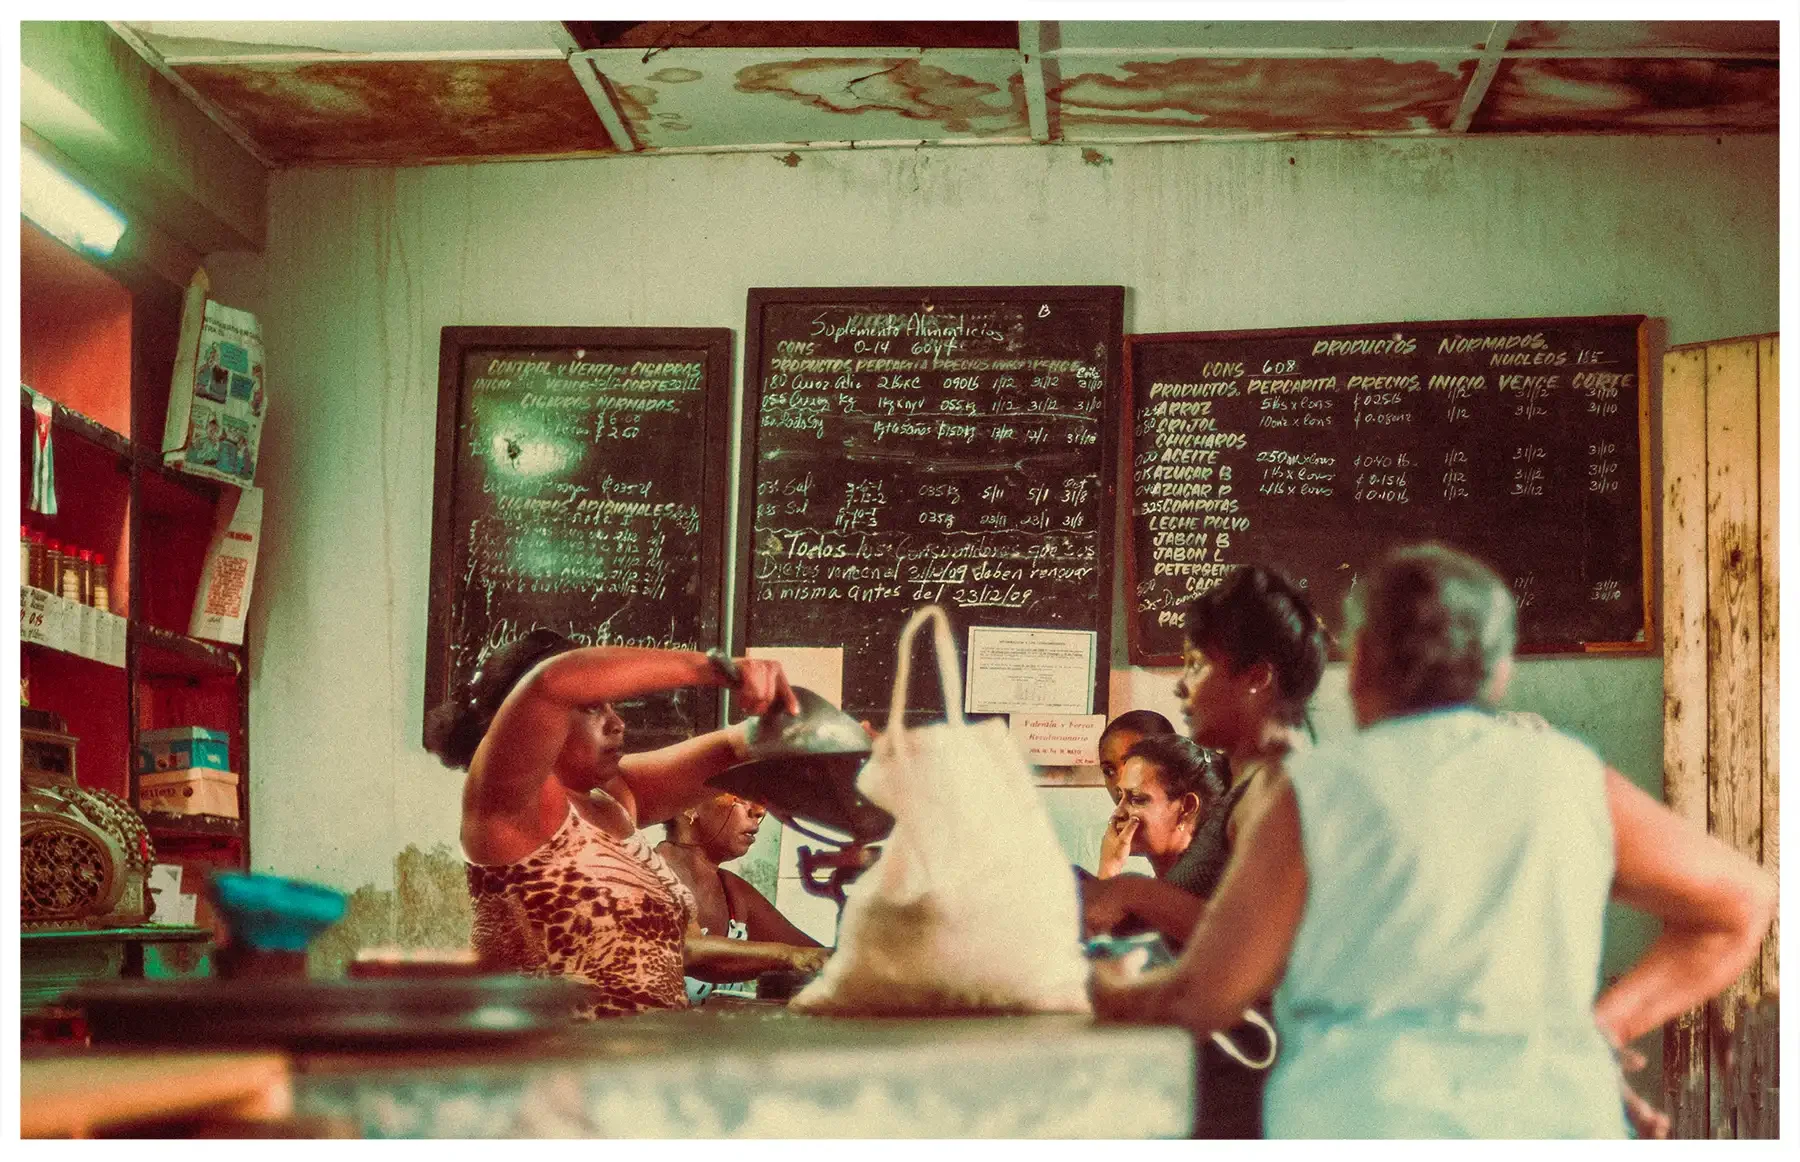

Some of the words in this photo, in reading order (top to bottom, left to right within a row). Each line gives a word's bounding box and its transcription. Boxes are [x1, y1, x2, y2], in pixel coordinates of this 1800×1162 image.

[811, 311, 899, 343] Suplemento
[777, 340, 816, 355] CONS
[1312, 338, 1416, 356] PRODUCTOS
[772, 358, 853, 373] PRODUCTOS
[1490, 352, 1568, 366] NUCLEOS
[487, 359, 550, 377] CONTROL
[630, 361, 702, 378] CIGARROS
[1203, 362, 1244, 377] CONS
[1263, 360, 1296, 374] 608
[1499, 373, 1560, 391] VENCE
[1571, 372, 1633, 389] CORTE
[1156, 401, 1212, 417] ARROZ
[1155, 433, 1248, 450] CHICHAROS
[1161, 448, 1220, 464] ACEITE
[1153, 465, 1213, 481] AZUCAR
[1151, 482, 1212, 498] AZUCAR
[1162, 499, 1240, 514] COMPOTAS
[1149, 515, 1200, 531] LECHE
[1203, 517, 1250, 531] POLVO
[784, 532, 847, 559] Todos
[1152, 532, 1208, 547] JABON
[1215, 532, 1231, 548] B
[1152, 547, 1208, 562] JABON
[1214, 549, 1225, 562] L
[780, 585, 842, 600] misma
[847, 581, 902, 602] antes
[952, 583, 1034, 606] 23/12/09
